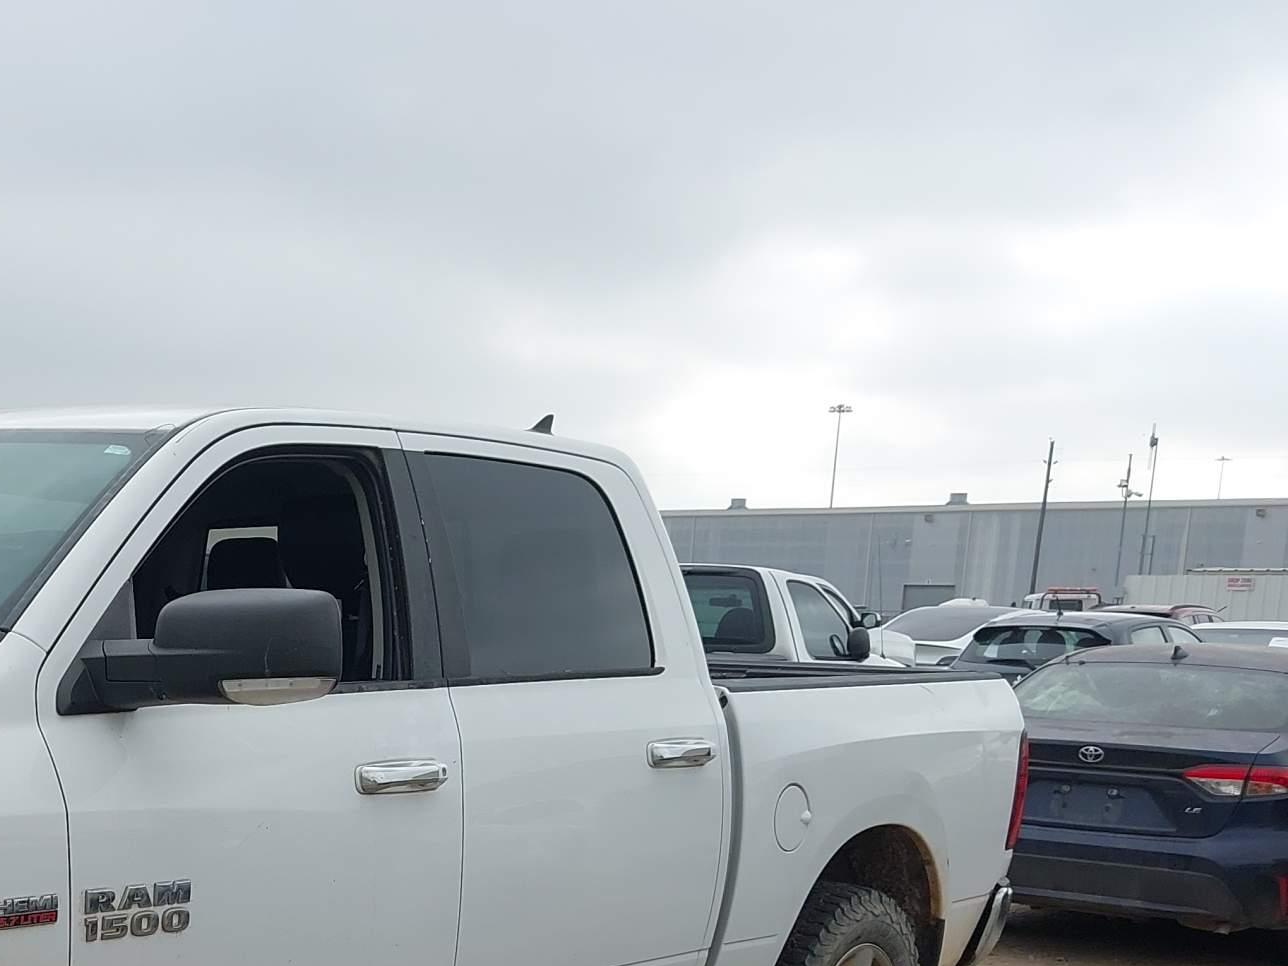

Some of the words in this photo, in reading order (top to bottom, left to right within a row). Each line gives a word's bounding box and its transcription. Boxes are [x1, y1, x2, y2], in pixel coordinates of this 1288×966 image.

[84, 879, 192, 915] RAM
[19, 910, 57, 926] LITER
[85, 907, 190, 942] 1500
